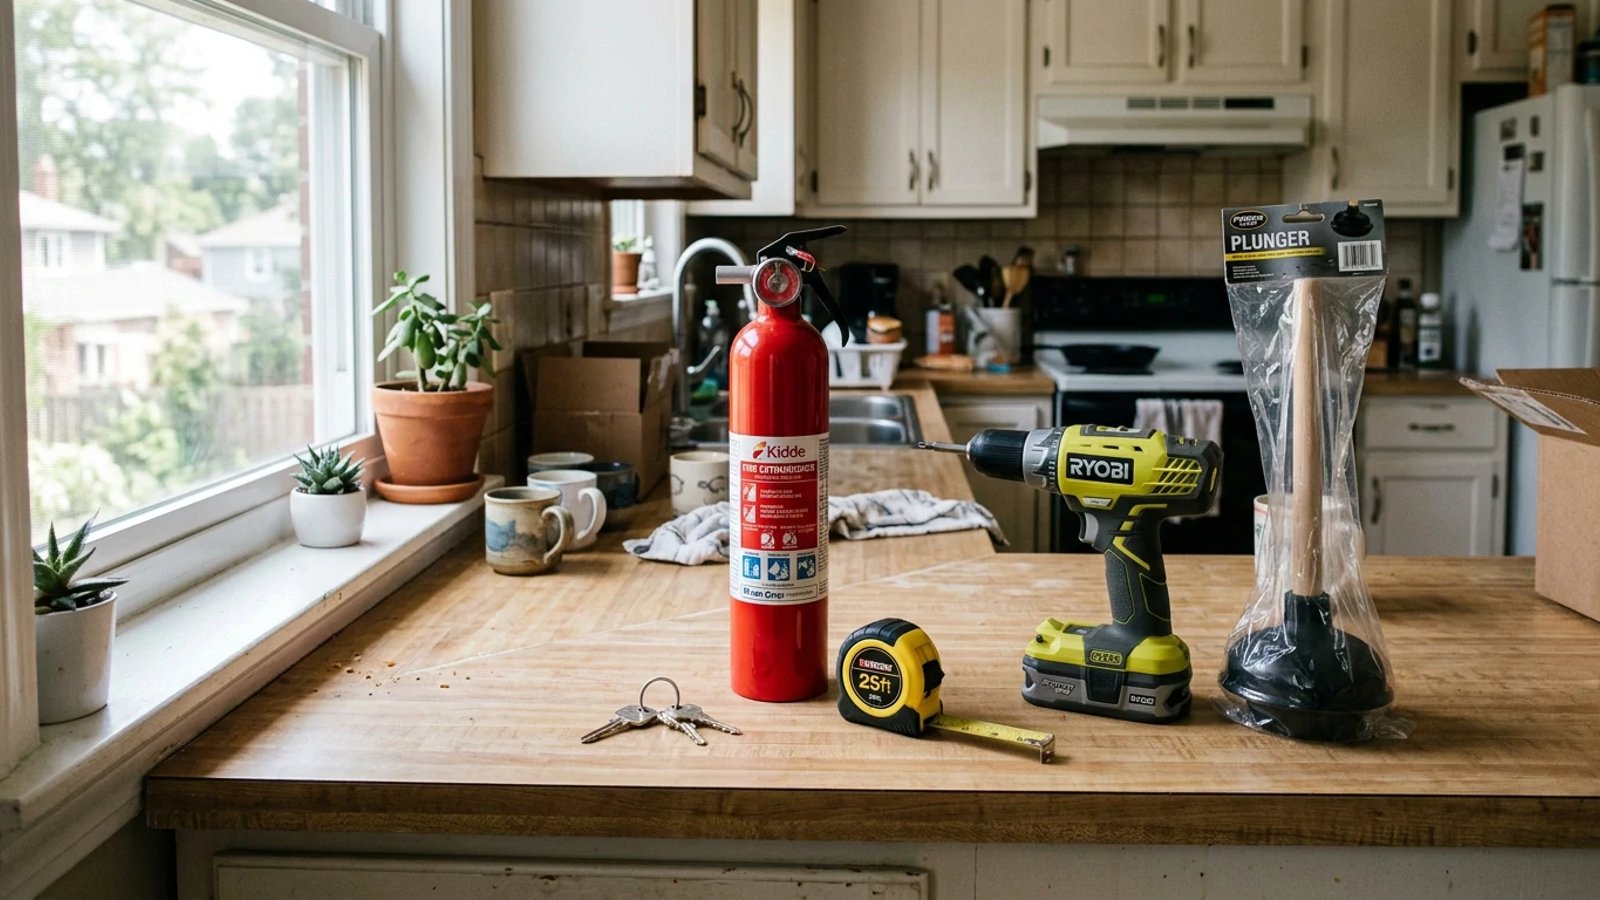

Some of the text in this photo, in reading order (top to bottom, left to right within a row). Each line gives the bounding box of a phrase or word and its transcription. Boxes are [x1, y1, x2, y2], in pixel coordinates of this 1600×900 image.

[1230, 230, 1311, 251] PLUNGER
[767, 445, 806, 458] Kidde
[1069, 457, 1129, 480] RYOBI
